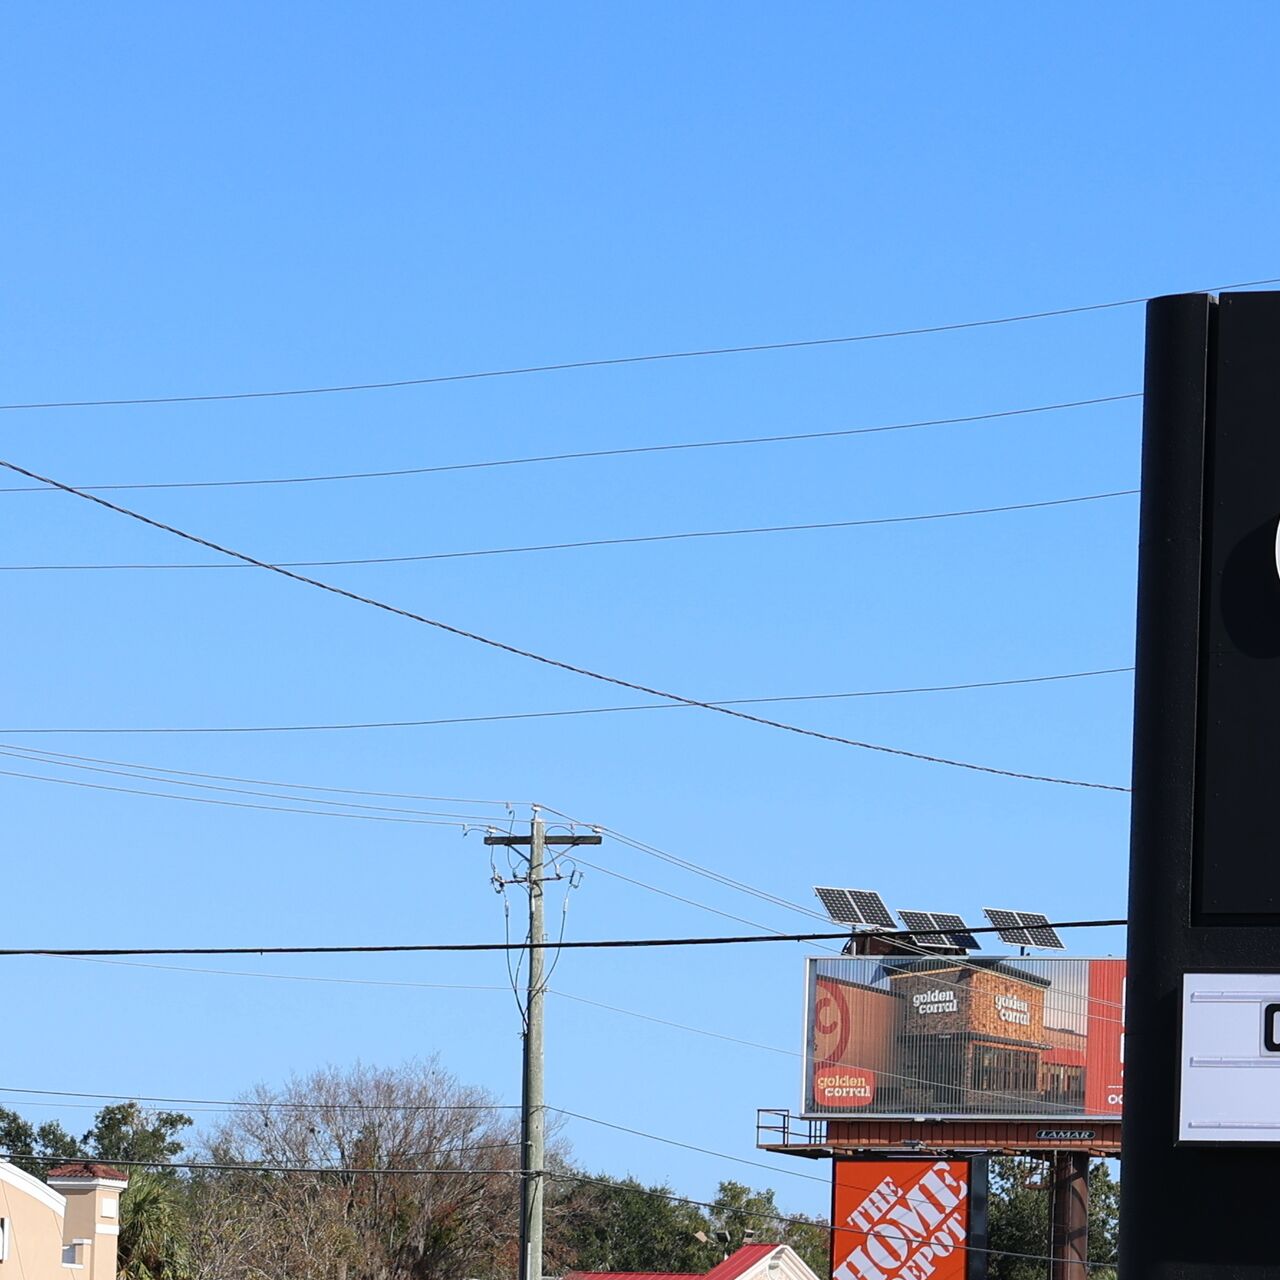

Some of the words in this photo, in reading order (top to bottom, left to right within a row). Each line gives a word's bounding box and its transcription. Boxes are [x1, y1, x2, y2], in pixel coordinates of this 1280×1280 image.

[912, 989, 955, 1008] golden
[918, 999, 959, 1014] corral
[994, 992, 1029, 1012] golden
[1000, 1008, 1030, 1025] corral
[817, 1075, 867, 1089] golden
[825, 1083, 871, 1097] corral
[1040, 1130, 1090, 1139] LAMAR
[847, 1176, 903, 1232] THE
